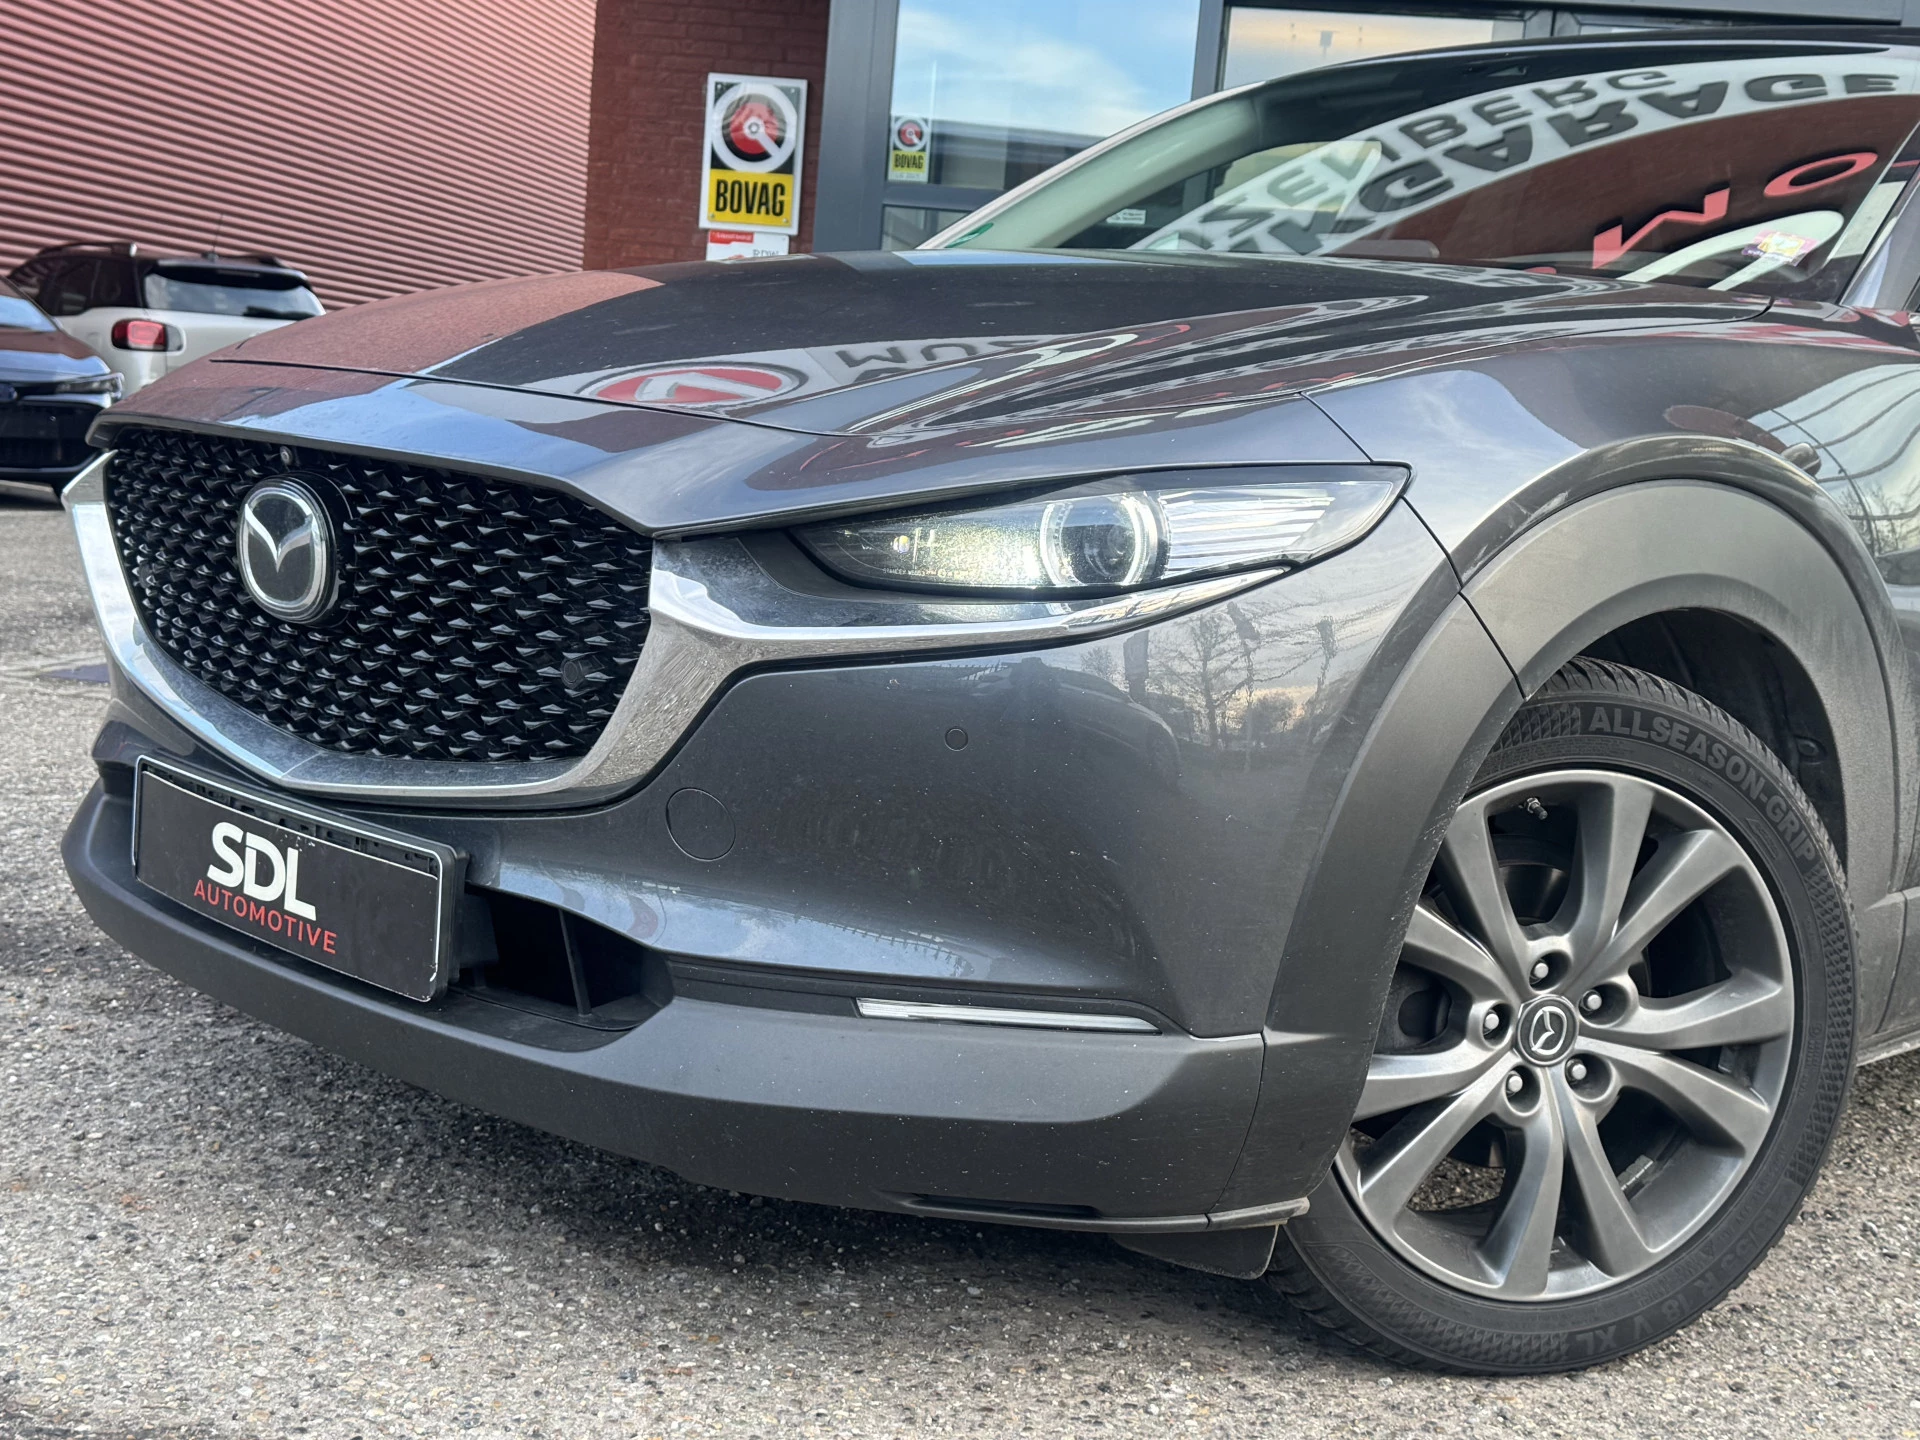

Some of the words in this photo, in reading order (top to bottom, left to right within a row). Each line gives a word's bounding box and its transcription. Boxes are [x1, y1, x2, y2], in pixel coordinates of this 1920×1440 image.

[894, 153, 924, 170] BOVAG
[715, 179, 785, 217] BOVAG
[1588, 706, 1817, 863] ALLSEASON-GRIP
[206, 822, 317, 921] SDL
[193, 879, 338, 955] AUTOMOTIVE
[1694, 1270, 1720, 1293] R
[1661, 1293, 1690, 1319] 18
[1577, 1326, 1617, 1353] XL
[1632, 1315, 1653, 1341] V
